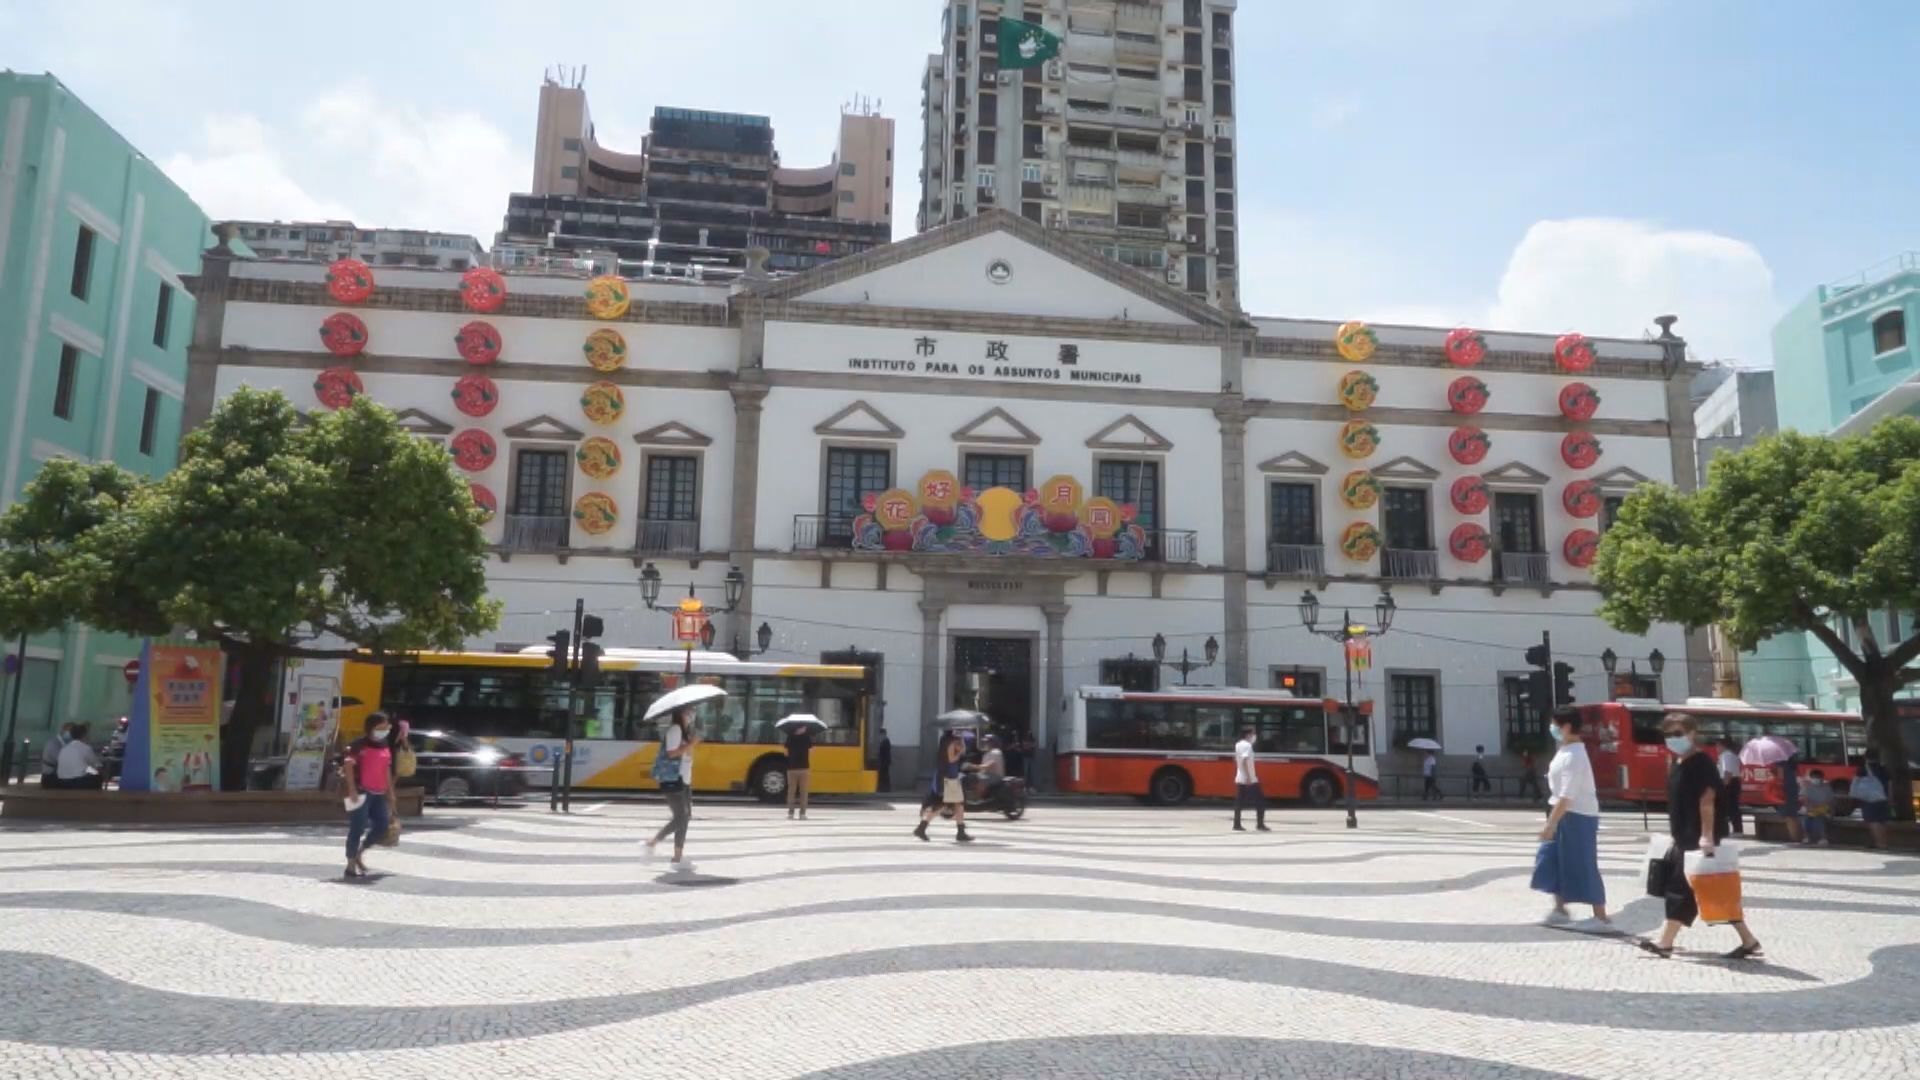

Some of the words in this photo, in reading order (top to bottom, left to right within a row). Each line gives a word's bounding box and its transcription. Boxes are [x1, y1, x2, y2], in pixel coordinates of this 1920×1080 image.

[849, 358, 916, 372] INSTITUTO
[925, 362, 958, 374] PARA
[968, 364, 985, 376] OS
[994, 366, 1061, 379] ASSUNTOS
[1070, 371, 1142, 384] MUNICIPAIS
